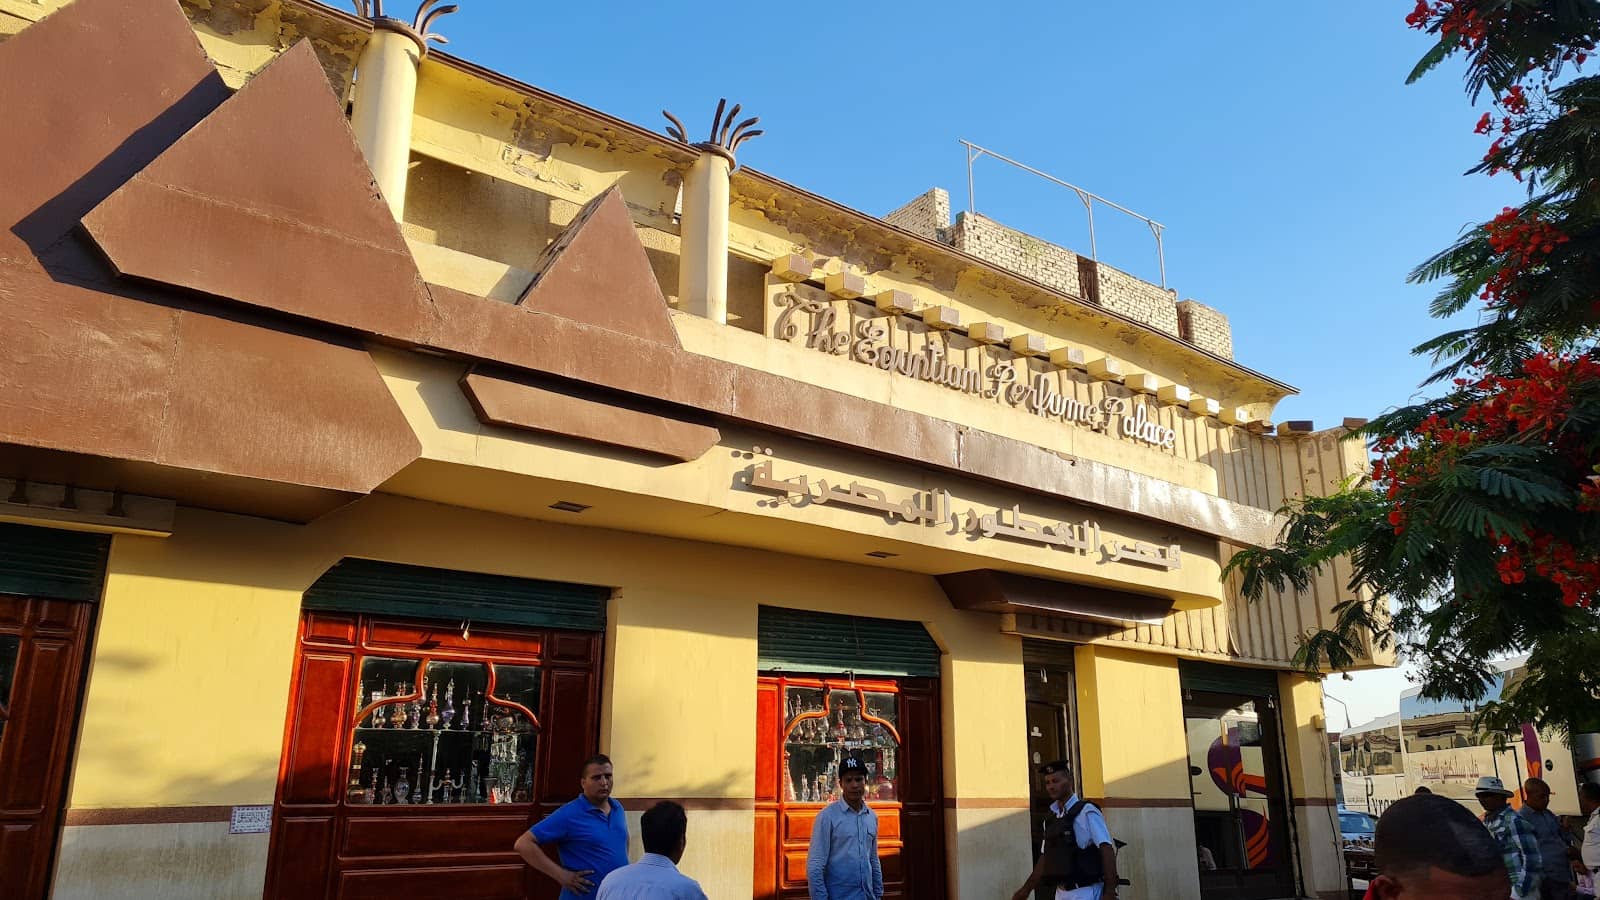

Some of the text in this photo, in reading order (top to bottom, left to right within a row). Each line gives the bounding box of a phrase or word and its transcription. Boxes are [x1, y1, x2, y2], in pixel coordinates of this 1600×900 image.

[779, 284, 851, 356] The
[987, 364, 1100, 423] Perfume
[1096, 396, 1176, 449] Palace
[751, 446, 951, 523] المصرية
[965, 503, 1100, 552] العطور
